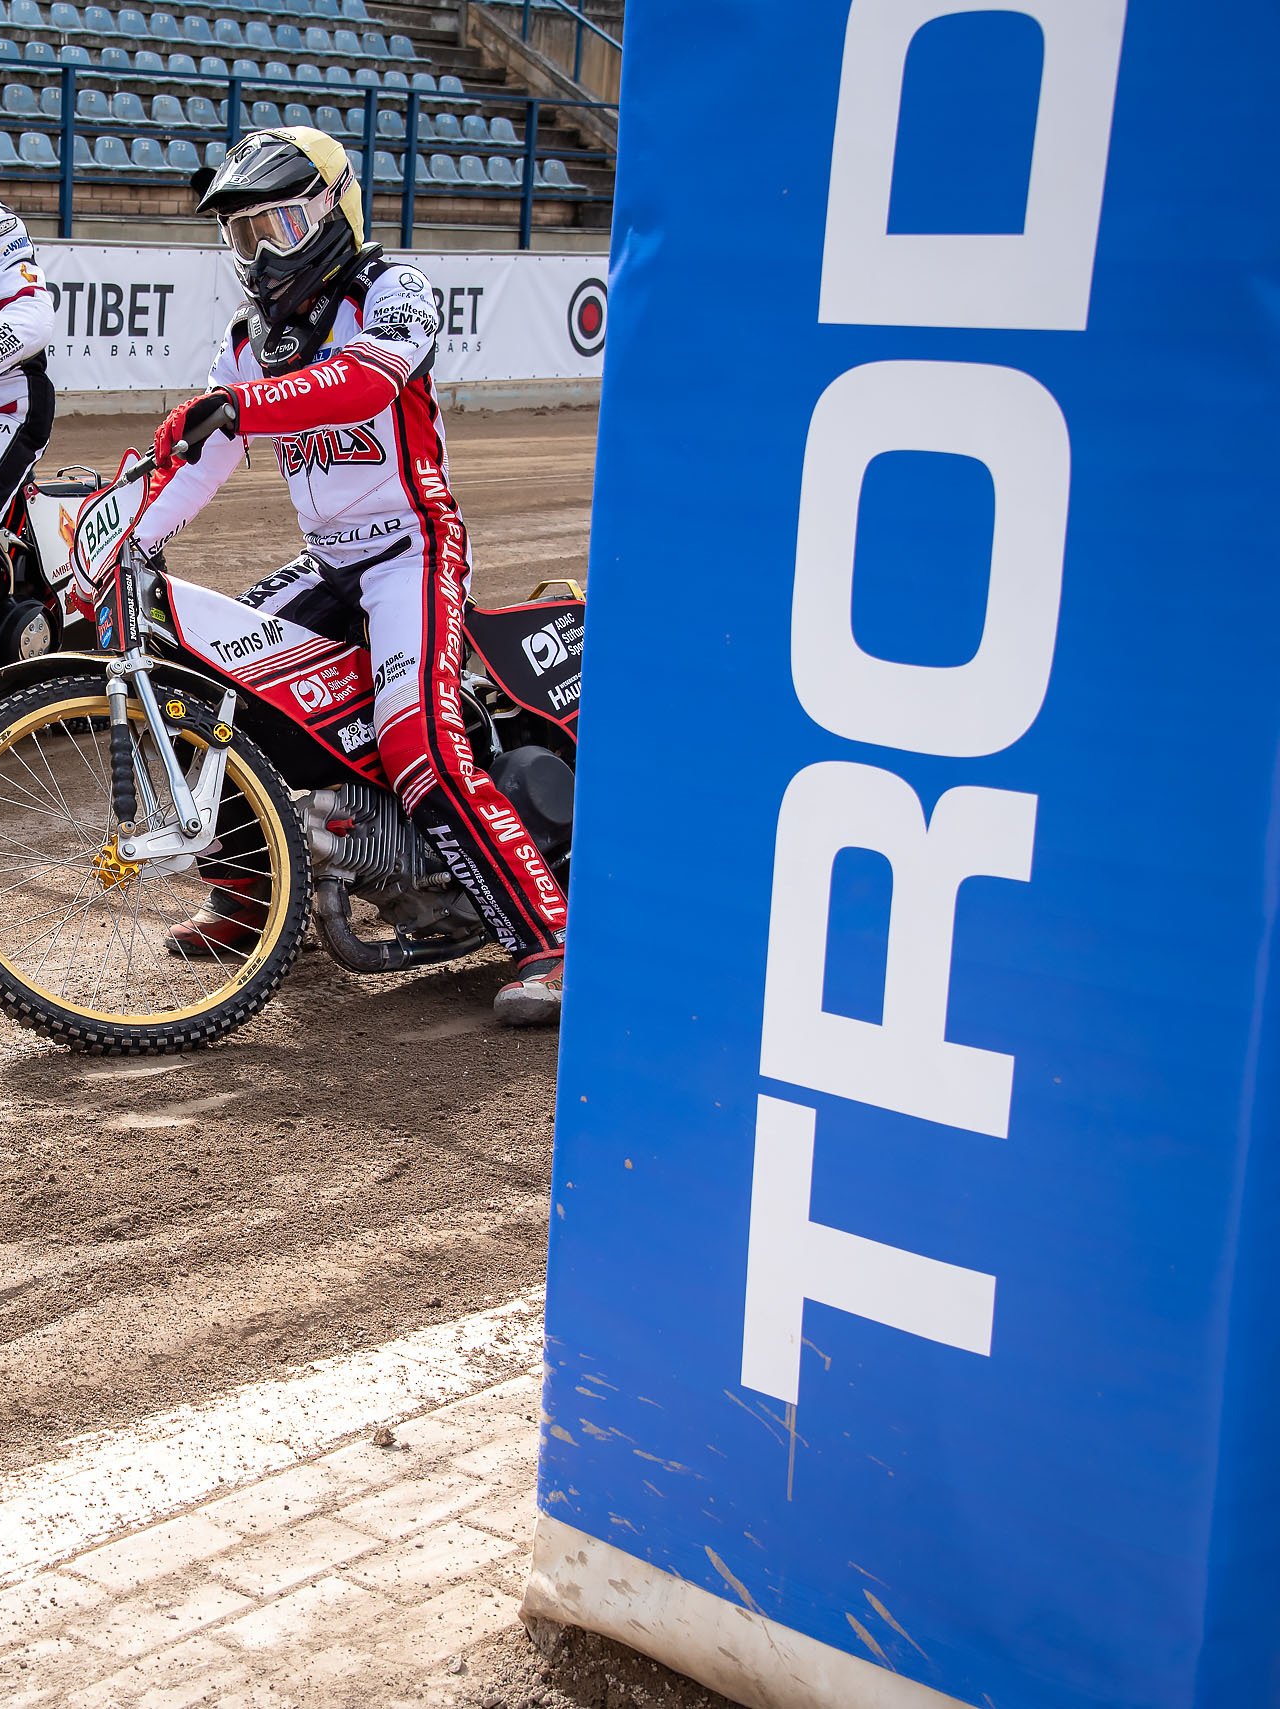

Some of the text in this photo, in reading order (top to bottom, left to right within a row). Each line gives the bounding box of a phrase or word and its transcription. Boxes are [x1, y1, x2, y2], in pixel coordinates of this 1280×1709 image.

[46, 281, 174, 337] PTIBET
[110, 341, 170, 357] BĀRS
[237, 360, 350, 410] Trans MF
[416, 458, 448, 499] MF
[85, 495, 121, 554] BAU
[51, 562, 72, 580] AMBE
[553, 612, 576, 631] ADAC
[210, 618, 284, 664] Trans MF
[439, 604, 463, 677] Trans
[561, 625, 586, 645] Stiftun
[384, 650, 405, 668] ADAC
[386, 656, 416, 676] Stiftung
[320, 665, 340, 681] ADAC
[328, 670, 359, 691] Stiftung
[386, 668, 407, 684] Sport
[332, 685, 357, 702] Sport
[439, 682, 466, 729] MF
[479, 804, 567, 922] Trans MF
